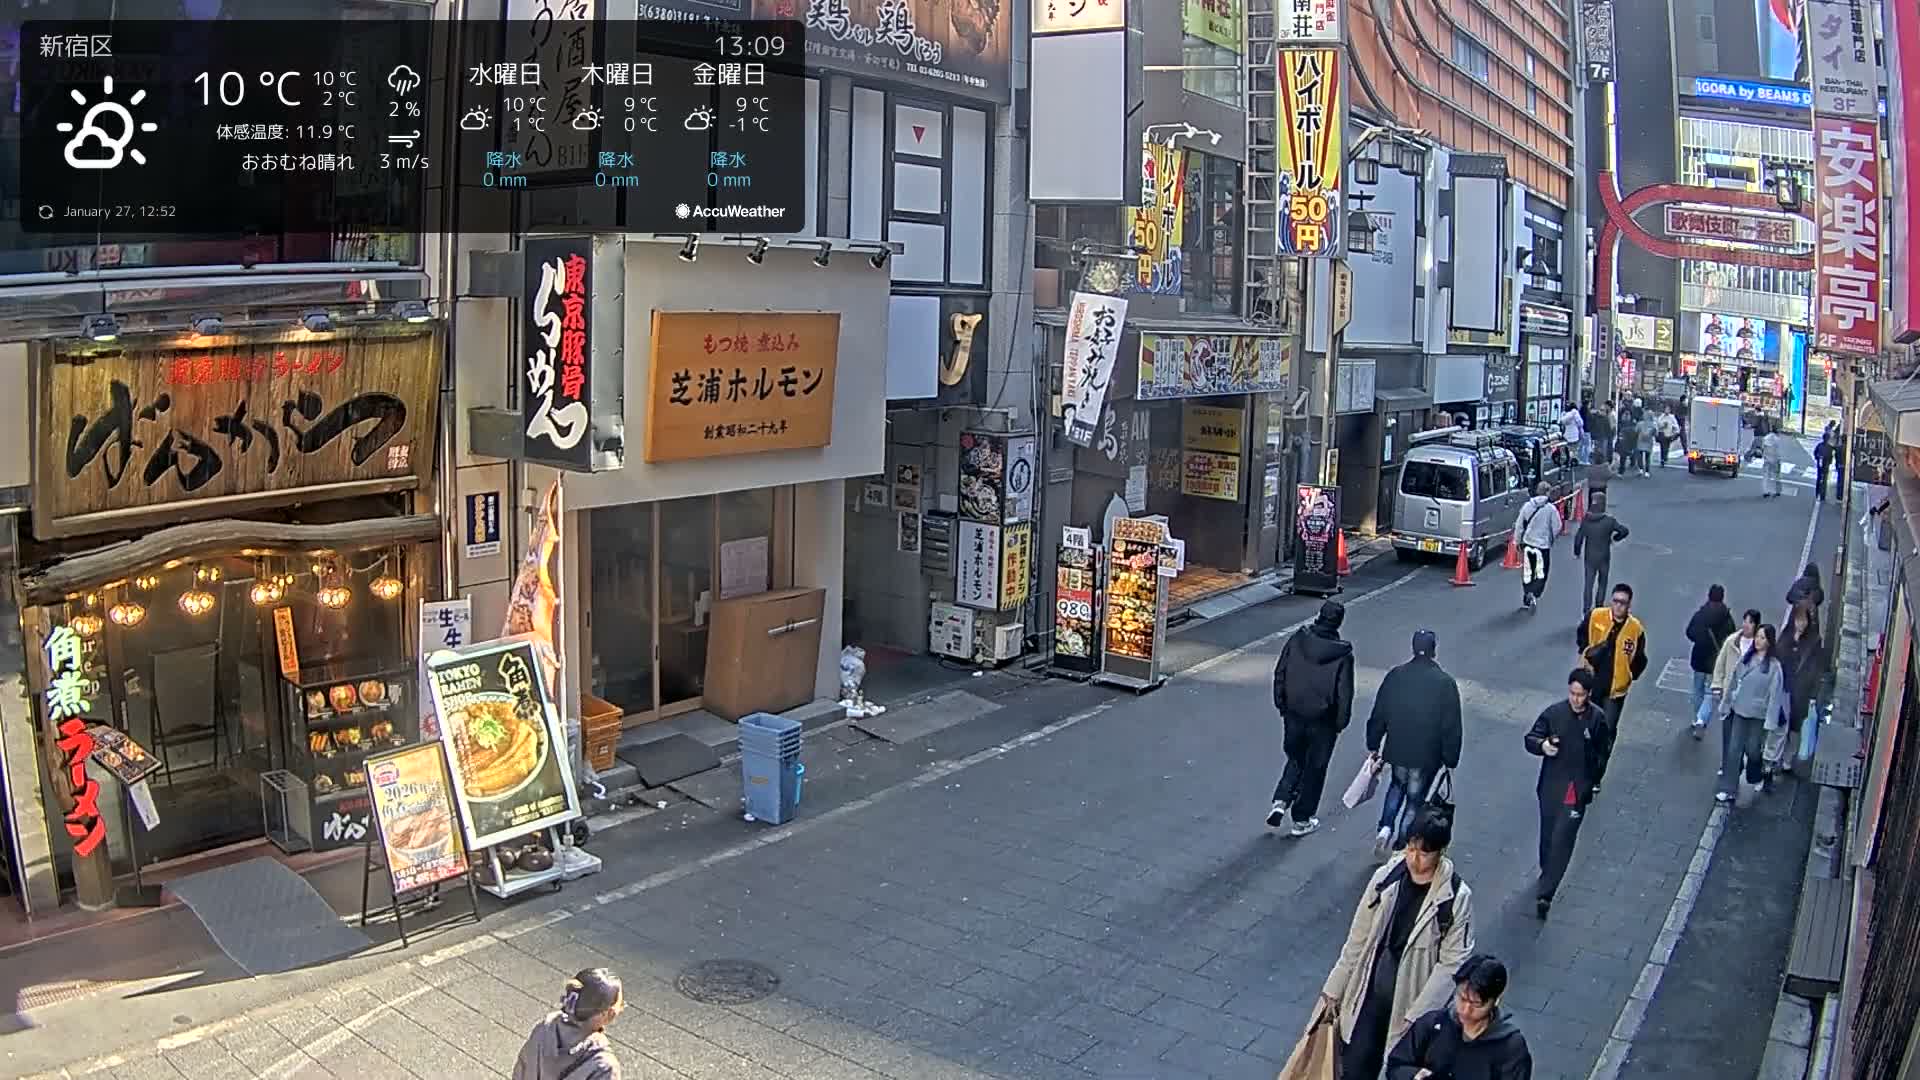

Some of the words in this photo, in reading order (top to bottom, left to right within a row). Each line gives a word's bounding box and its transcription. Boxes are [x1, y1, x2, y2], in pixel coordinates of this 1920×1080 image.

[1818, 14, 1842, 71] タイ
[1590, 63, 1611, 79] 7F
[1739, 85, 1754, 101] by
[1757, 86, 1800, 104] BEAMS
[1833, 97, 1857, 112] 3F
[1296, 55, 1323, 190] ハイボール
[1289, 194, 1329, 252] 50円
[1671, 212, 1793, 243] 歌舞伎町一番街
[1819, 126, 1877, 331] 安楽亭
[560, 253, 587, 401] 東京豚骨
[703, 333, 750, 355] もつ焼
[757, 331, 801, 353] 煮込み
[1819, 331, 1838, 348] 2F
[669, 365, 824, 407] 芝浦ホルモン
[703, 419, 789, 441] 創業昭和二十九年
[1057, 600, 1090, 618] 980
[437, 663, 482, 684] TOKYO
[441, 676, 483, 696] RAMEN
[44, 625, 106, 857] 角煮ラーメン
